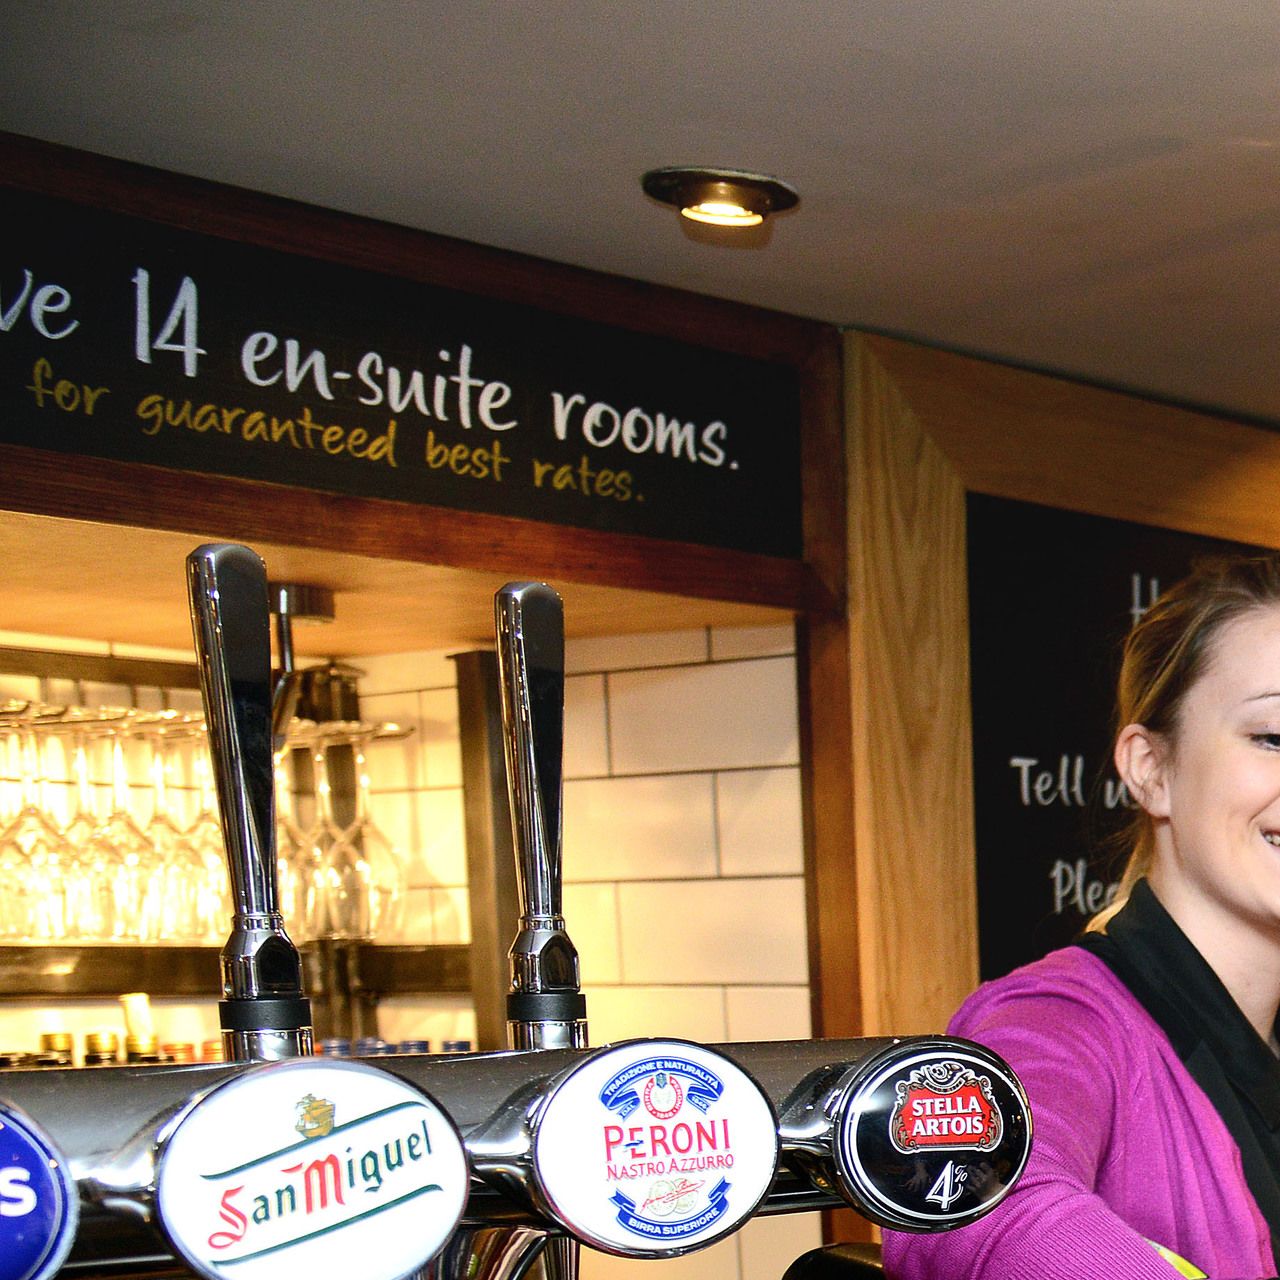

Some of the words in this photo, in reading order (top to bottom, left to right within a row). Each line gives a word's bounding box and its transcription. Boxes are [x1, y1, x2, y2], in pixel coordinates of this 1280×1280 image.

[132, 267, 208, 378] 14
[241, 330, 518, 432] en-suite
[551, 390, 740, 472] rooms.
[25, 356, 110, 416] for
[136, 391, 399, 470] guaranteed
[425, 430, 511, 484] best
[533, 452, 646, 503] rates.
[1009, 753, 1086, 807] Tell
[604, 1061, 656, 1097] TRADIZIONE
[912, 1096, 983, 1116] STELLA
[603, 1119, 730, 1162] PERONI
[911, 1116, 984, 1136] ARTOIS
[606, 1160, 666, 1180] NASTRO
[668, 1153, 735, 1174] AZZURRO
[628, 1217, 662, 1235] BIRRA
[662, 1207, 720, 1235] SUPERIORE
